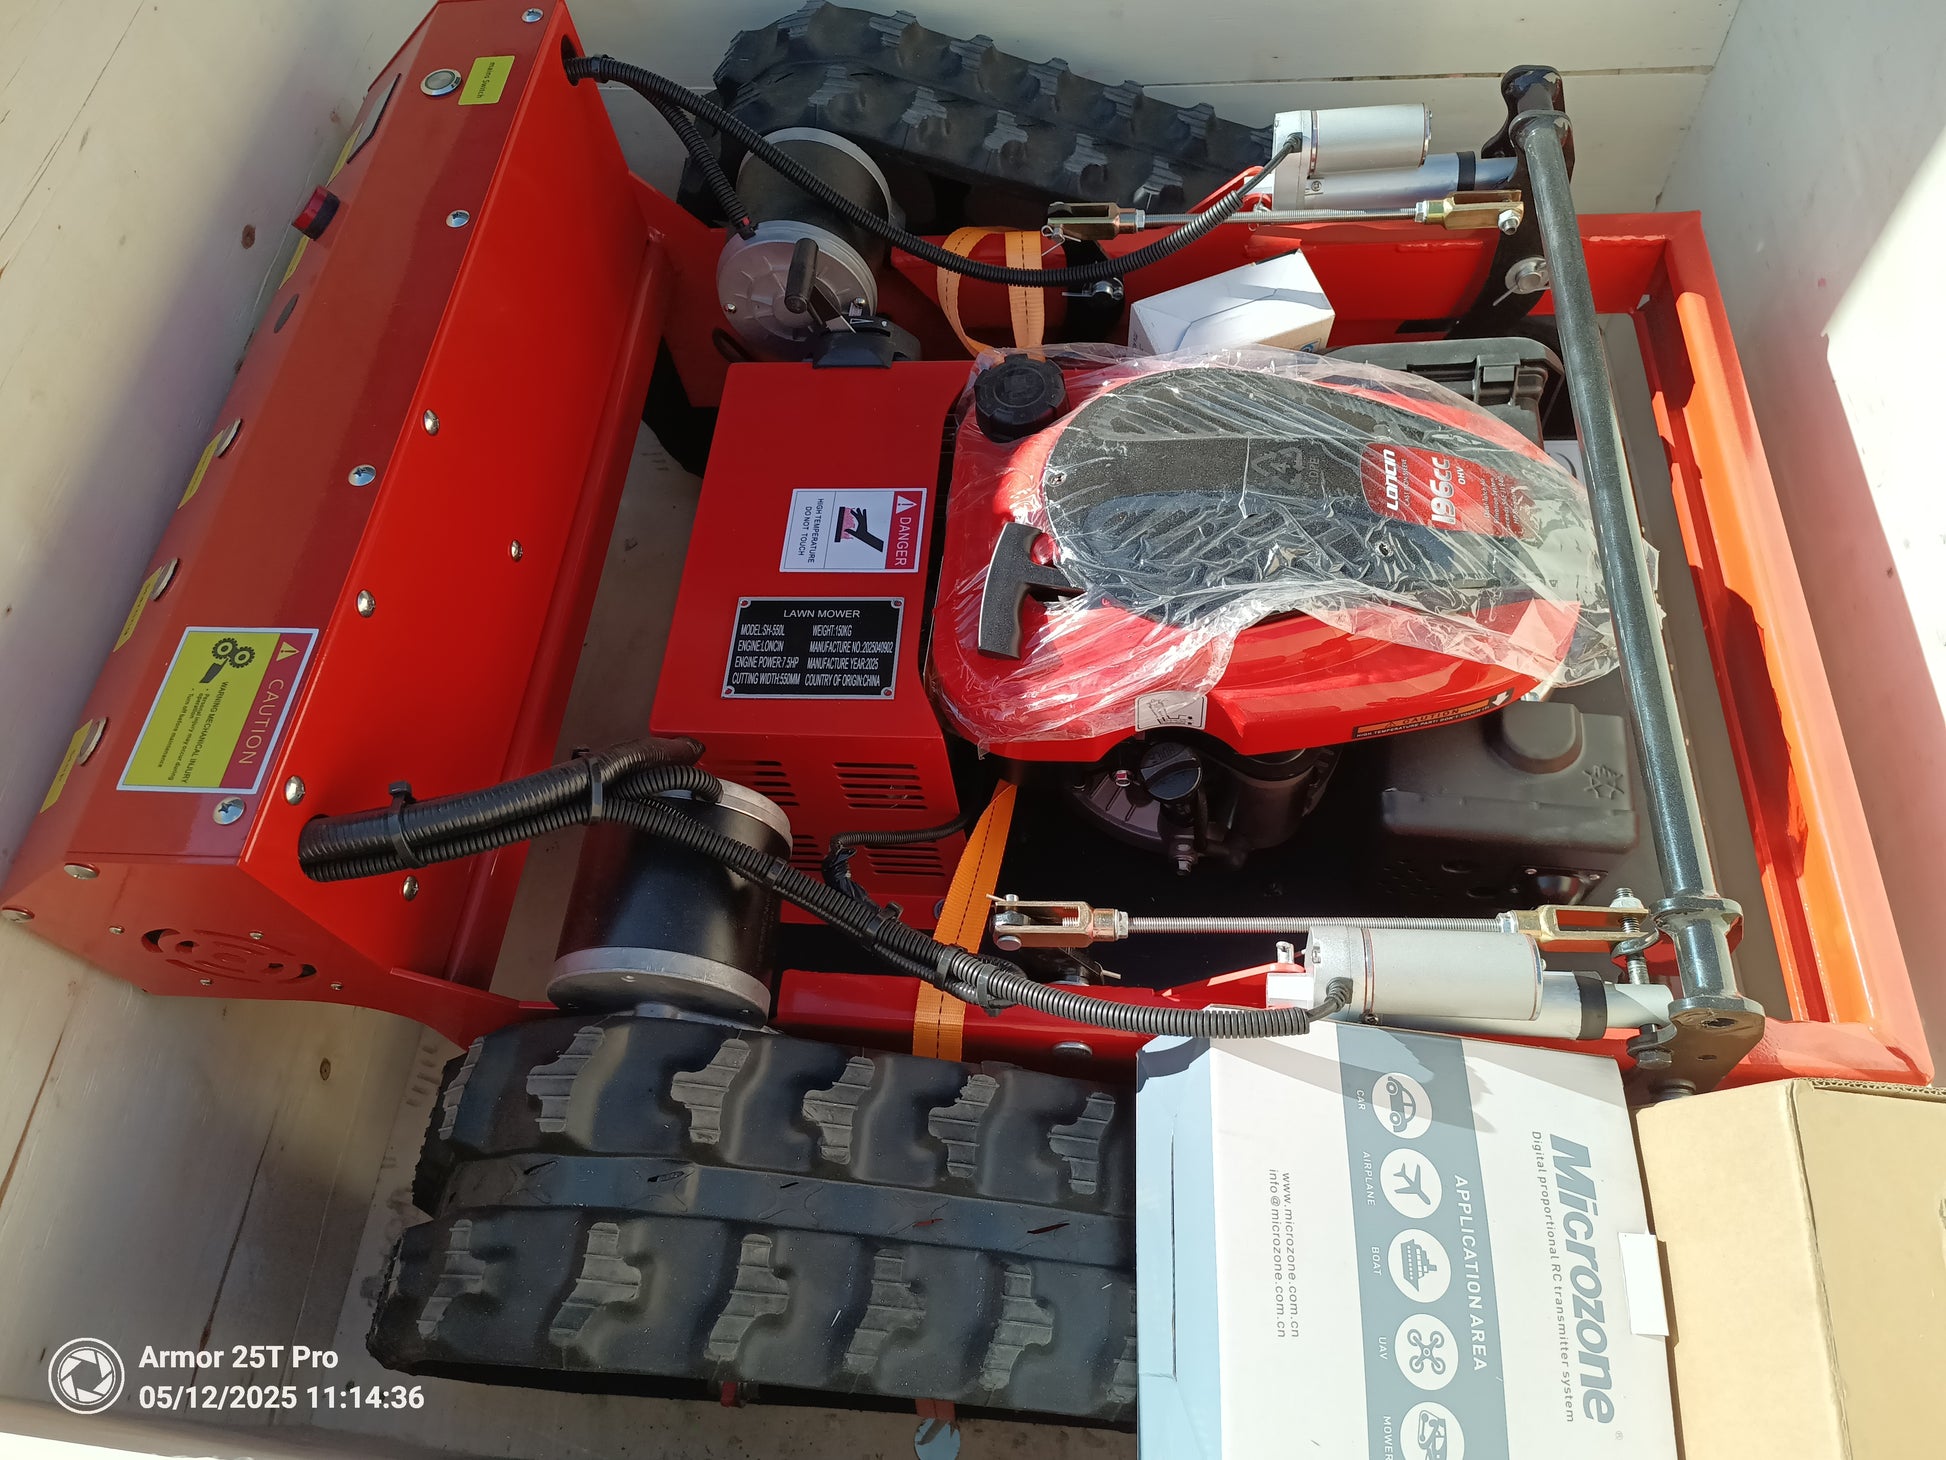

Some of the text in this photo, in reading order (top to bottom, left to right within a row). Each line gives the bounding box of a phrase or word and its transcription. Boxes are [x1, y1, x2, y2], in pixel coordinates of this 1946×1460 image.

[1456, 465, 1466, 485] OHV
[1429, 456, 1456, 525] 196cc
[798, 506, 812, 556] DO NOT TOUCH
[807, 498, 824, 563] HIGH TEMPERATURE
[895, 516, 912, 566] DANGER
[783, 609, 861, 618] LAWN MOWER
[740, 624, 785, 636] MODEL:SH-550L
[812, 624, 853, 637] WEIGHT:150KG
[737, 639, 785, 652] ENGINE:LONCIN
[808, 640, 851, 653] MANUFACTURE
[734, 656, 800, 669] ENGINE POWER:7.5HP
[806, 657, 879, 670] MANUFACTURE YEAR:2025
[731, 672, 801, 685] CUTTING WIDTH:550MM
[804, 673, 881, 687] COUNTRY OF ORIGIN:CHINA
[238, 678, 285, 764] CAUTION
[1403, 708, 1459, 724] CAUTION
[181, 681, 229, 784] WARNING MECHANICAL INJURY
[1374, 722, 1419, 735] TEMPERATURE
[1356, 1089, 1367, 1111] CAR
[1362, 1151, 1376, 1206] AIRPLANE
[1269, 1169, 1286, 1338] info@microzone.com.cn
[1282, 1171, 1300, 1338] www.microzone.com.cn
[1371, 1246, 1382, 1276] BOAT
[1454, 1174, 1488, 1371] APPLICATION AREA
[1531, 1130, 1574, 1423] Digital proportional RC transmitter system
[1550, 1133, 1615, 1424] Microzone
[1378, 1336, 1388, 1360] UAV
